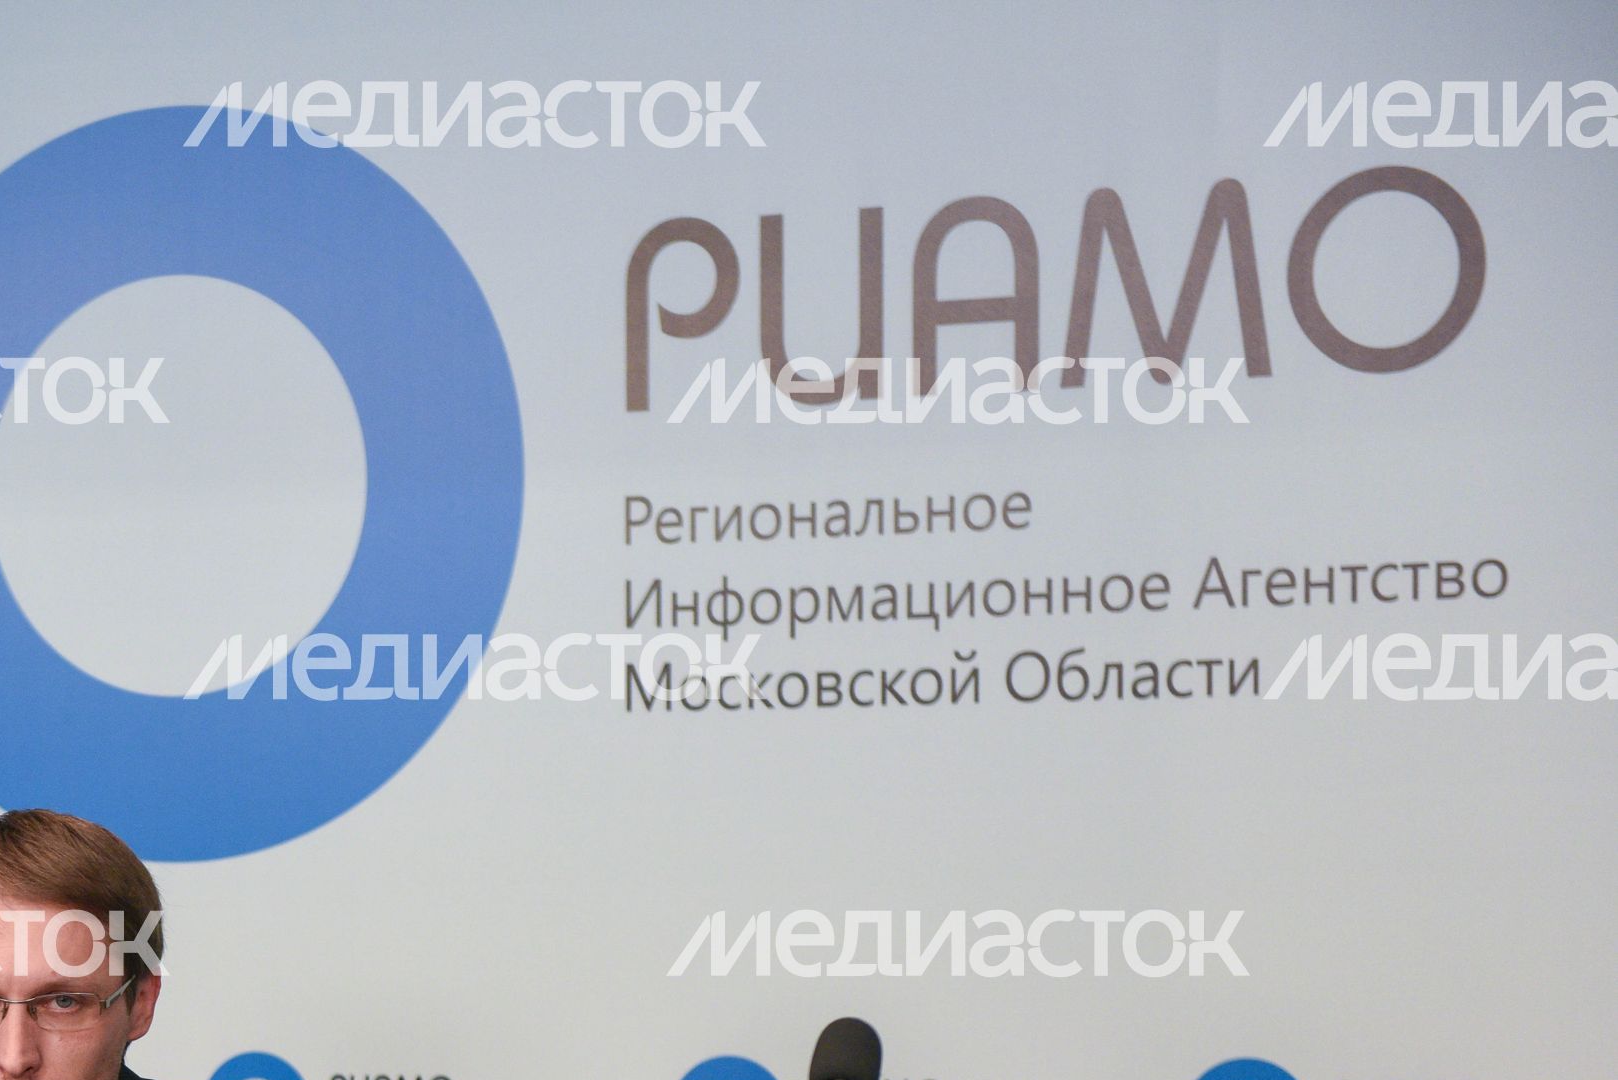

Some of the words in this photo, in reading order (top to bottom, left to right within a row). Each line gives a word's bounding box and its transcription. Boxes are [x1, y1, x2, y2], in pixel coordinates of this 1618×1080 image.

[625, 165, 1486, 411] РИАМО
[623, 490, 1033, 546] Региональное
[623, 566, 1171, 641] Информационное
[1194, 555, 1509, 610] Агентство
[623, 650, 981, 712] Московской
[1004, 648, 1262, 704] Области
